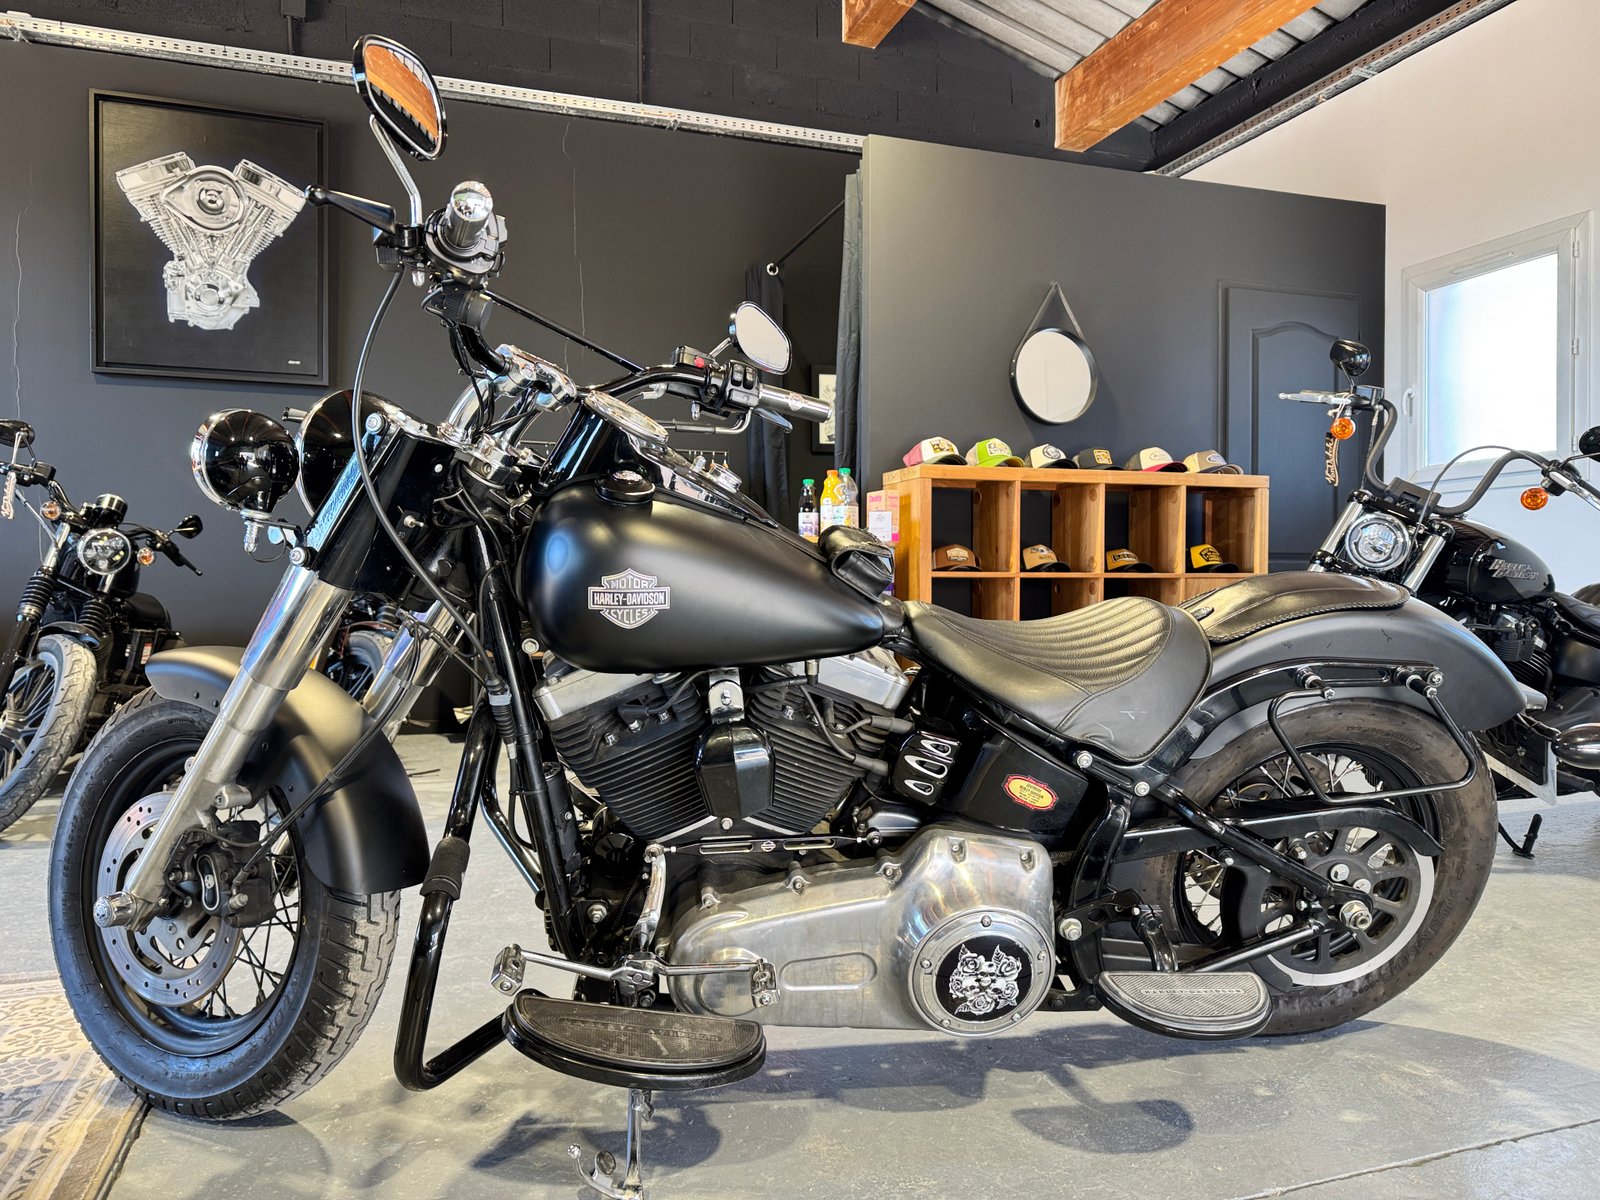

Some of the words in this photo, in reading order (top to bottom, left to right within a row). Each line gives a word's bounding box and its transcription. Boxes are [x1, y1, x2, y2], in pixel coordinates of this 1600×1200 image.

[610, 574, 649, 589] MOTOR
[593, 592, 665, 606] HARLEY-DAVIDSON
[610, 608, 648, 624] CYCLES
